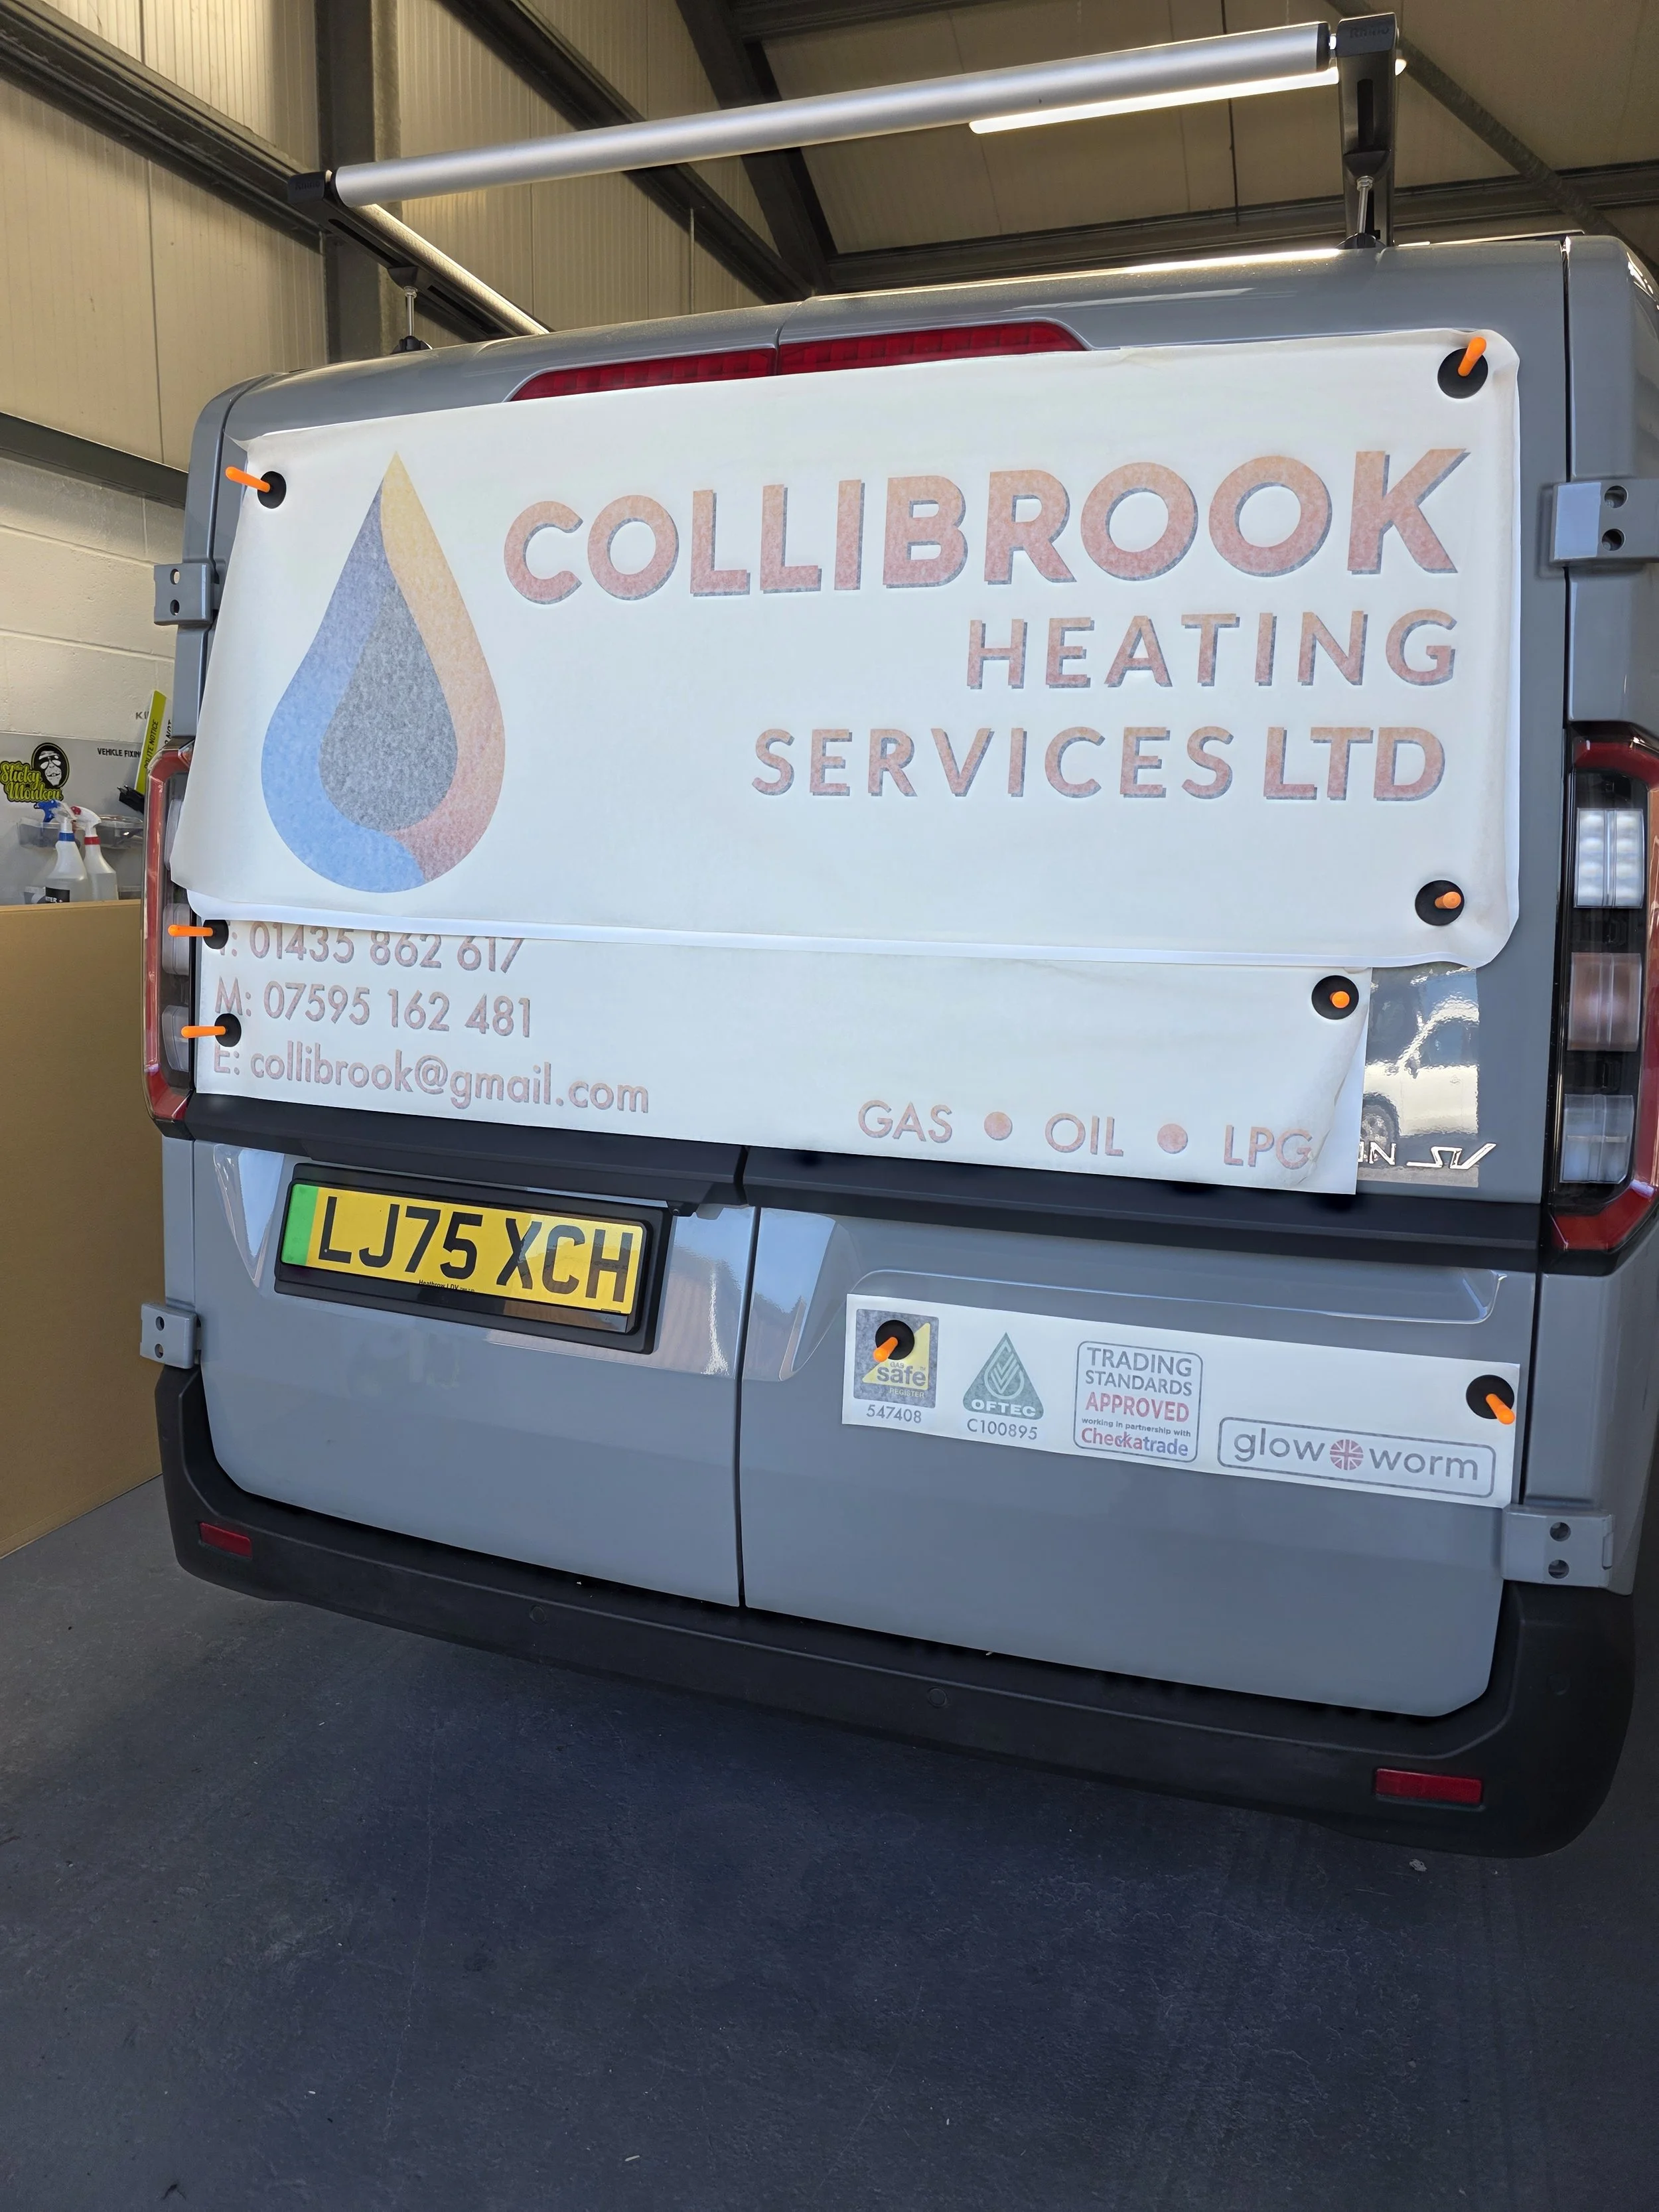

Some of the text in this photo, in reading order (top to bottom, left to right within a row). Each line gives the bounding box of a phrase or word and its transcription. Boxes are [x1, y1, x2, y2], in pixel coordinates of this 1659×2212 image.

[504, 448, 1470, 605] COLLIBROOK
[967, 609, 1457, 690] HEATING
[149, 719, 159, 745] NOTICE
[97, 747, 123, 757] VEHICLE
[751, 725, 1446, 802] SERVICES LTD
[1, 763, 40, 790] Sticky
[7, 782, 62, 800] Monkey
[250, 921, 356, 964] 01435
[370, 930, 443, 969] 862
[457, 936, 524, 974] 617
[214, 976, 530, 1038] M: 07595 162 481
[214, 1040, 649, 1114] E: collibrook@gmail.com
[857, 1099, 1313, 1170] GAS OIL LPG
[318, 1195, 634, 1303] LJ75 XCH
[877, 1365, 927, 1386] safe
[1086, 1347, 1192, 1377] TRADING
[889, 1388, 925, 1398] REGISTER
[1085, 1369, 1192, 1397] STANDARDS
[866, 1404, 922, 1424] 547408
[971, 1399, 1037, 1417] OFTEC
[1085, 1391, 1190, 1423] APPROVED
[967, 1418, 1038, 1440] C100895
[1081, 1427, 1189, 1457] Checkatrade
[1082, 1418, 1114, 1428] working
[1125, 1423, 1172, 1436] partnership
[1173, 1428, 1191, 1438] with
[1234, 1428, 1479, 1481] glow worm
